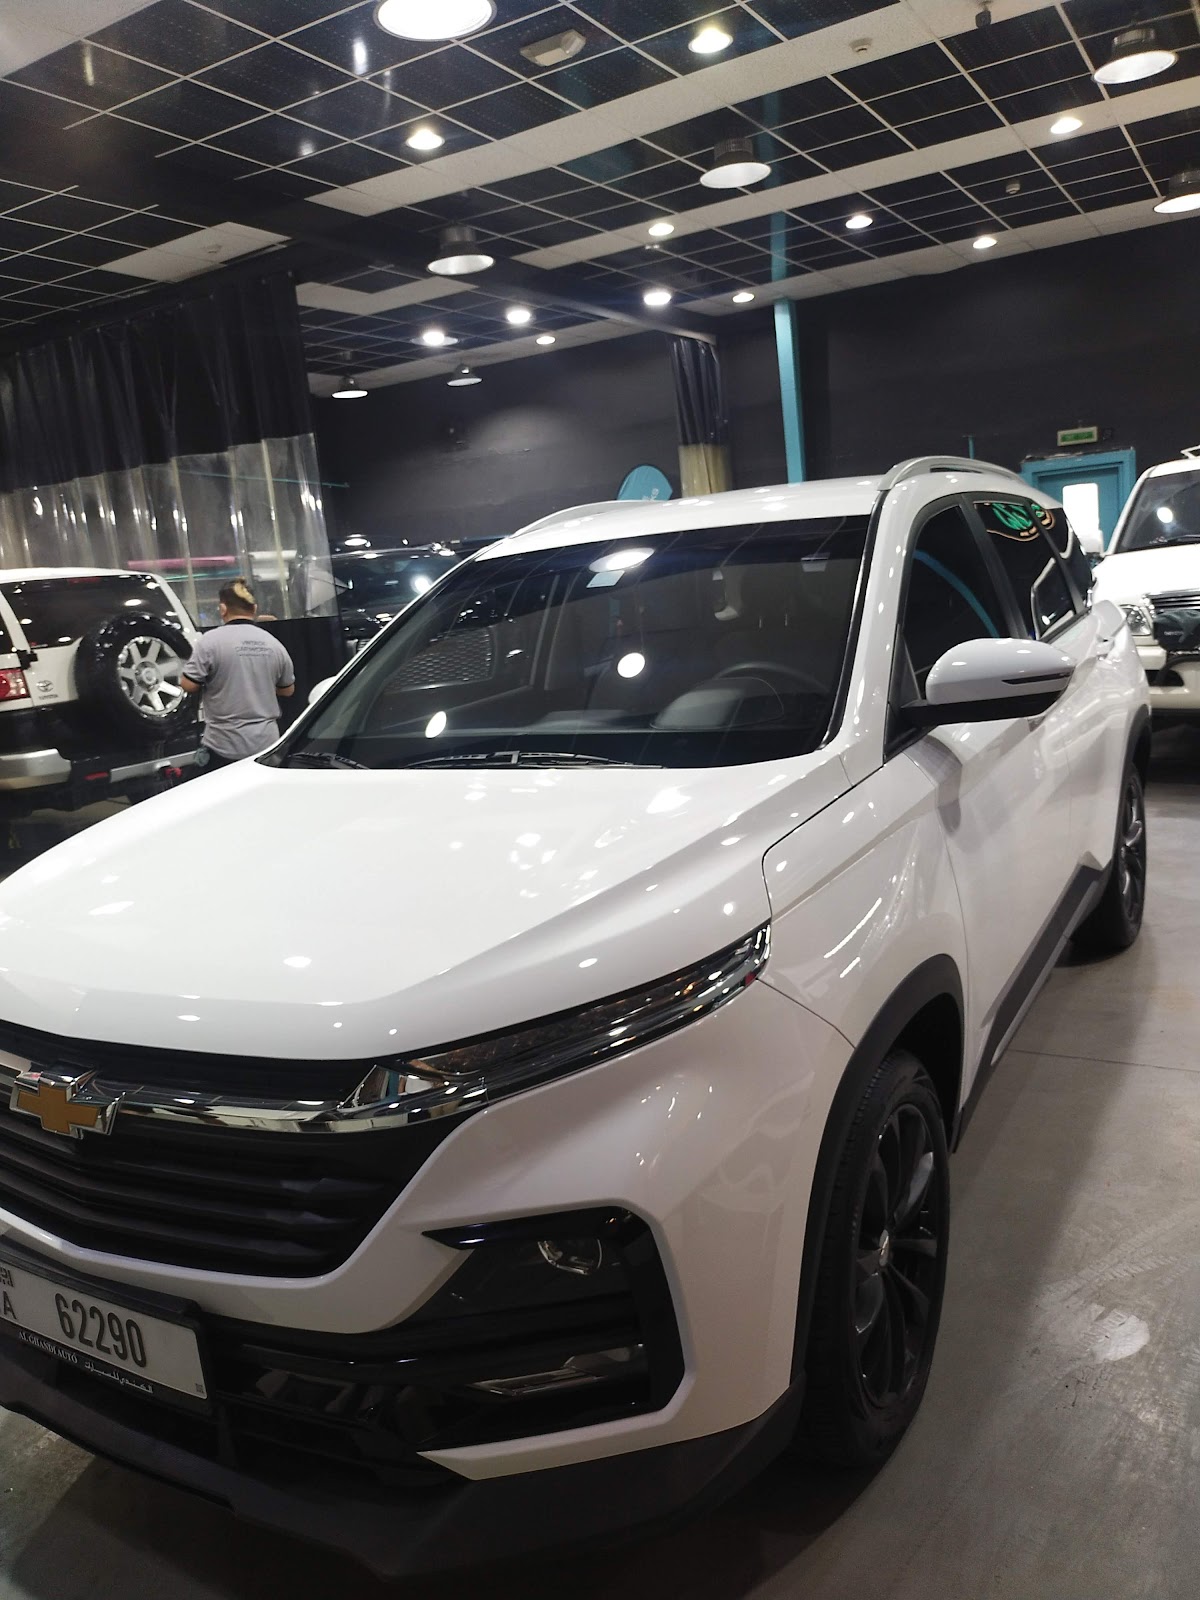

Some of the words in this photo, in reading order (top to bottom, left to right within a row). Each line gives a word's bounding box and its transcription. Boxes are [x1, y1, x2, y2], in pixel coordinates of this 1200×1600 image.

[3, 1290, 17, 1320] A
[54, 1292, 147, 1368] 62290
[57, 1348, 78, 1364] AUTO
